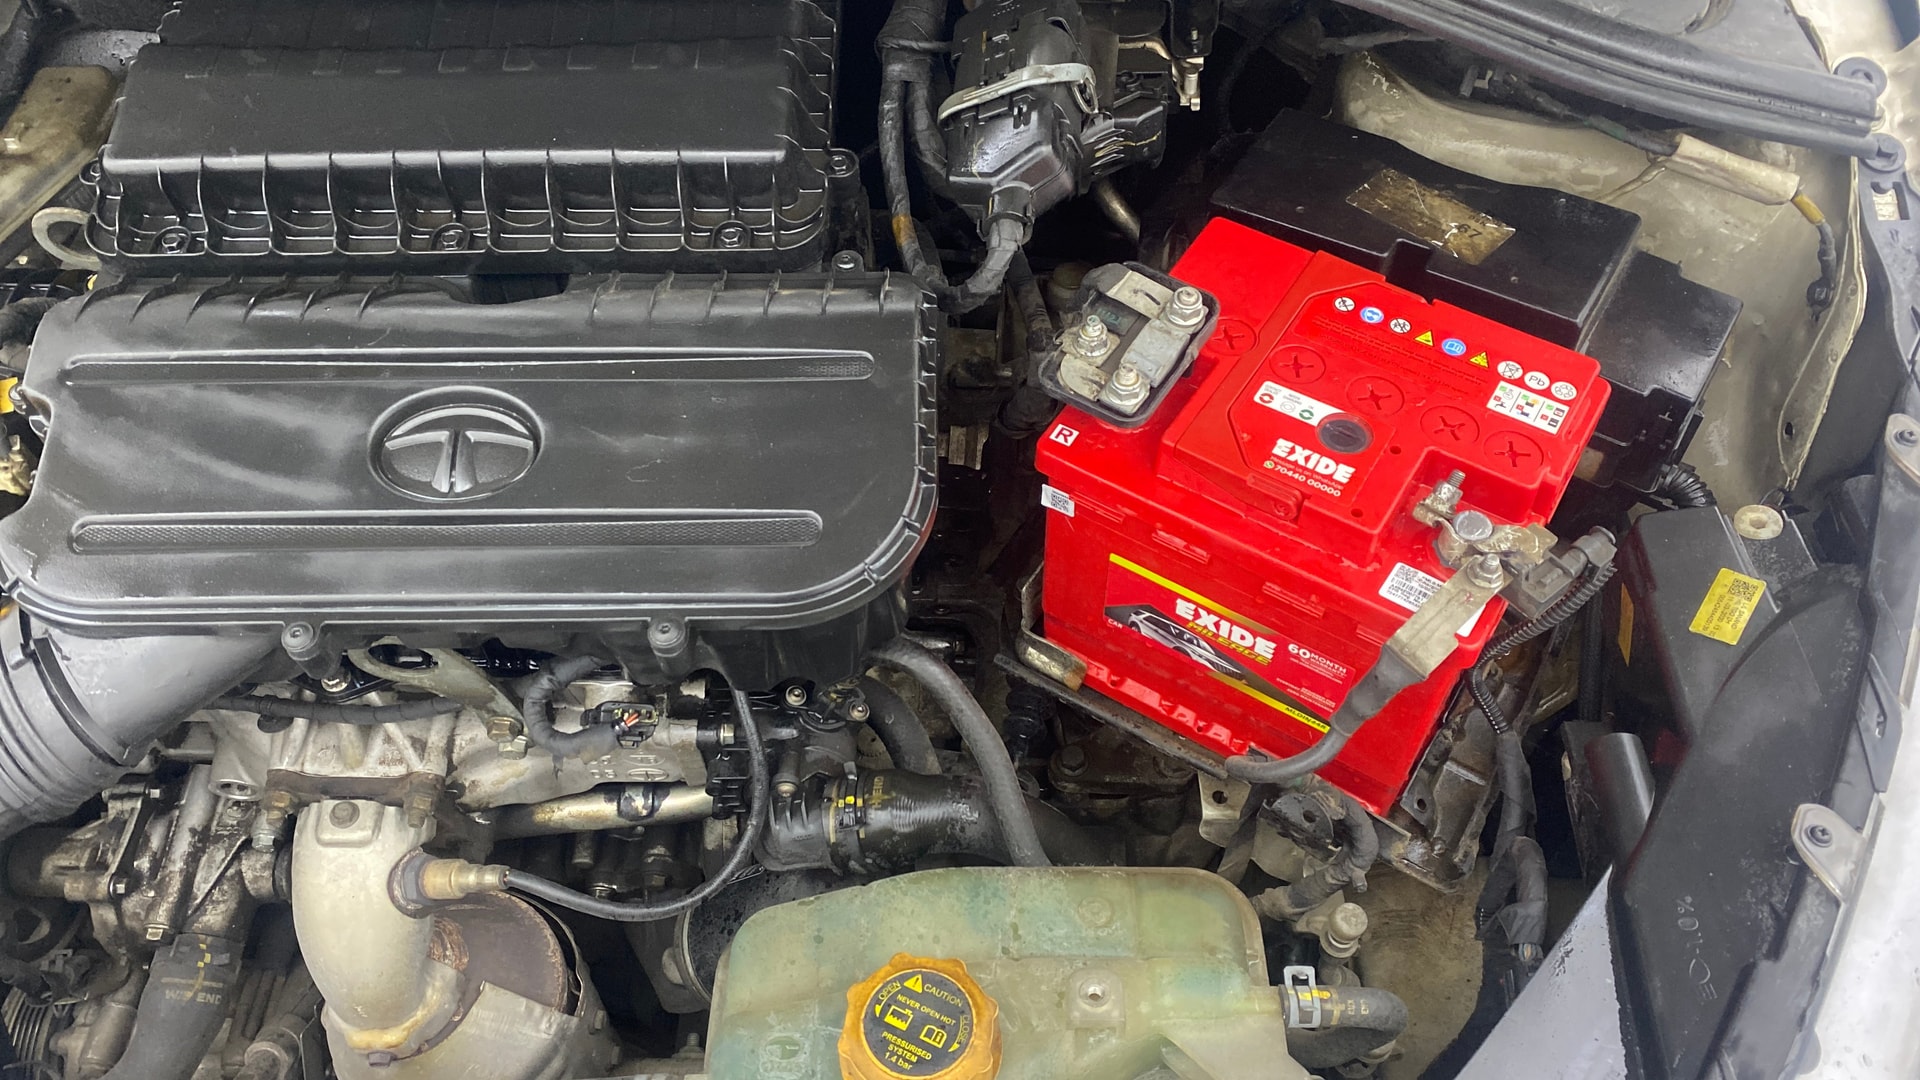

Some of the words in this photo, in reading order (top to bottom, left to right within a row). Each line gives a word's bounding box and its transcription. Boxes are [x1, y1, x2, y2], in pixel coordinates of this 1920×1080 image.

[1528, 375, 1545, 387] Pb
[1054, 427, 1074, 444] R
[1271, 438, 1356, 484] EXIDE
[1274, 464, 1306, 482] 70440
[1307, 475, 1341, 497] 00000
[1175, 598, 1277, 660] EXIDE
[1186, 621, 1272, 666] MILEAGE
[1288, 643, 1311, 659] 60
[1310, 652, 1347, 674] MONTH
[878, 980, 901, 1000] OPEN
[923, 983, 963, 1007] CAUTION
[897, 994, 920, 1010] NEVER
[920, 1005, 941, 1019] OPEN
[940, 1014, 956, 1026] HOT
[961, 1014, 970, 1044] CLOSE
[882, 1031, 932, 1060] PRESSURISED
[888, 1043, 918, 1063] SYSTEM
[884, 1051, 896, 1063] 1.4
[897, 1057, 913, 1071] bar
